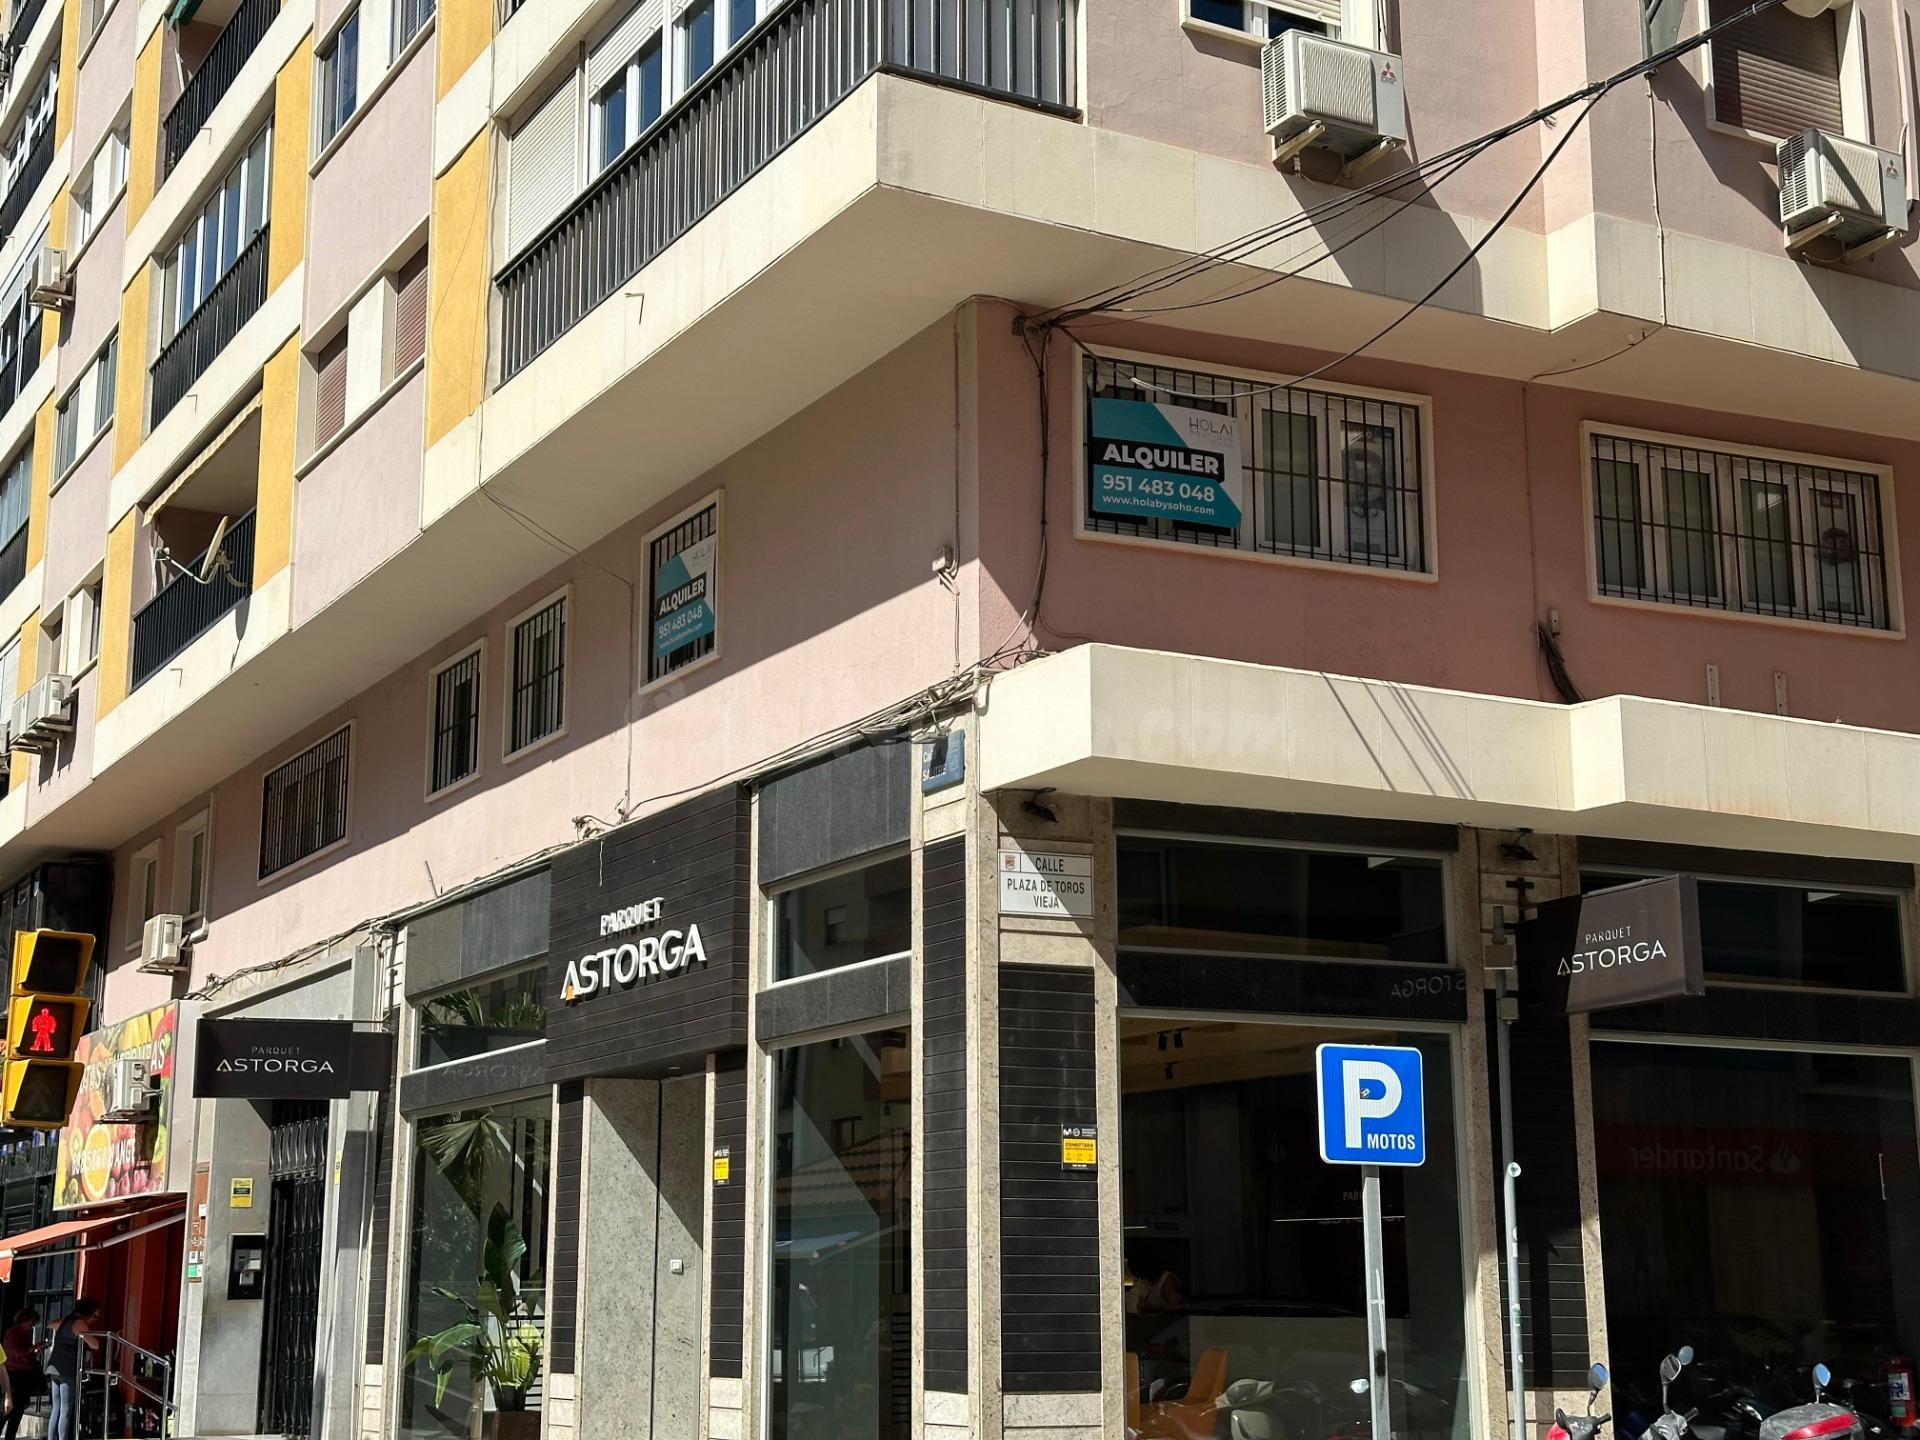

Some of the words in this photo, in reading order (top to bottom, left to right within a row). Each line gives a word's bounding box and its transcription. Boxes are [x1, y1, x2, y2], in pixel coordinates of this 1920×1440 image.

[1102, 443, 1220, 476] ALQUILER
[1102, 474, 1133, 492] 951
[1138, 478, 1174, 497] 483
[1179, 483, 1215, 502] 048
[1102, 495, 1215, 516] www.holabysoho.com
[658, 577, 705, 616] ALQUILER
[658, 621, 672, 639] 951
[671, 613, 687, 631] 483
[687, 605, 703, 623] 048
[1035, 857, 1065, 872] CALLE
[1007, 878, 1038, 892] PLAZA
[1040, 880, 1053, 892] DE
[1054, 880, 1085, 894] TOROS
[1033, 895, 1060, 909] VIEJA
[600, 896, 665, 936] PARQUET
[1585, 925, 1632, 945] PARQUET
[560, 923, 707, 1001] ASTORGA
[1556, 939, 1667, 976] ASTORGA
[251, 1046, 301, 1055] PARQUET
[216, 1058, 335, 1074] ASTORGA
[1342, 1059, 1403, 1149] P
[1366, 1133, 1416, 1150] MOTOS
